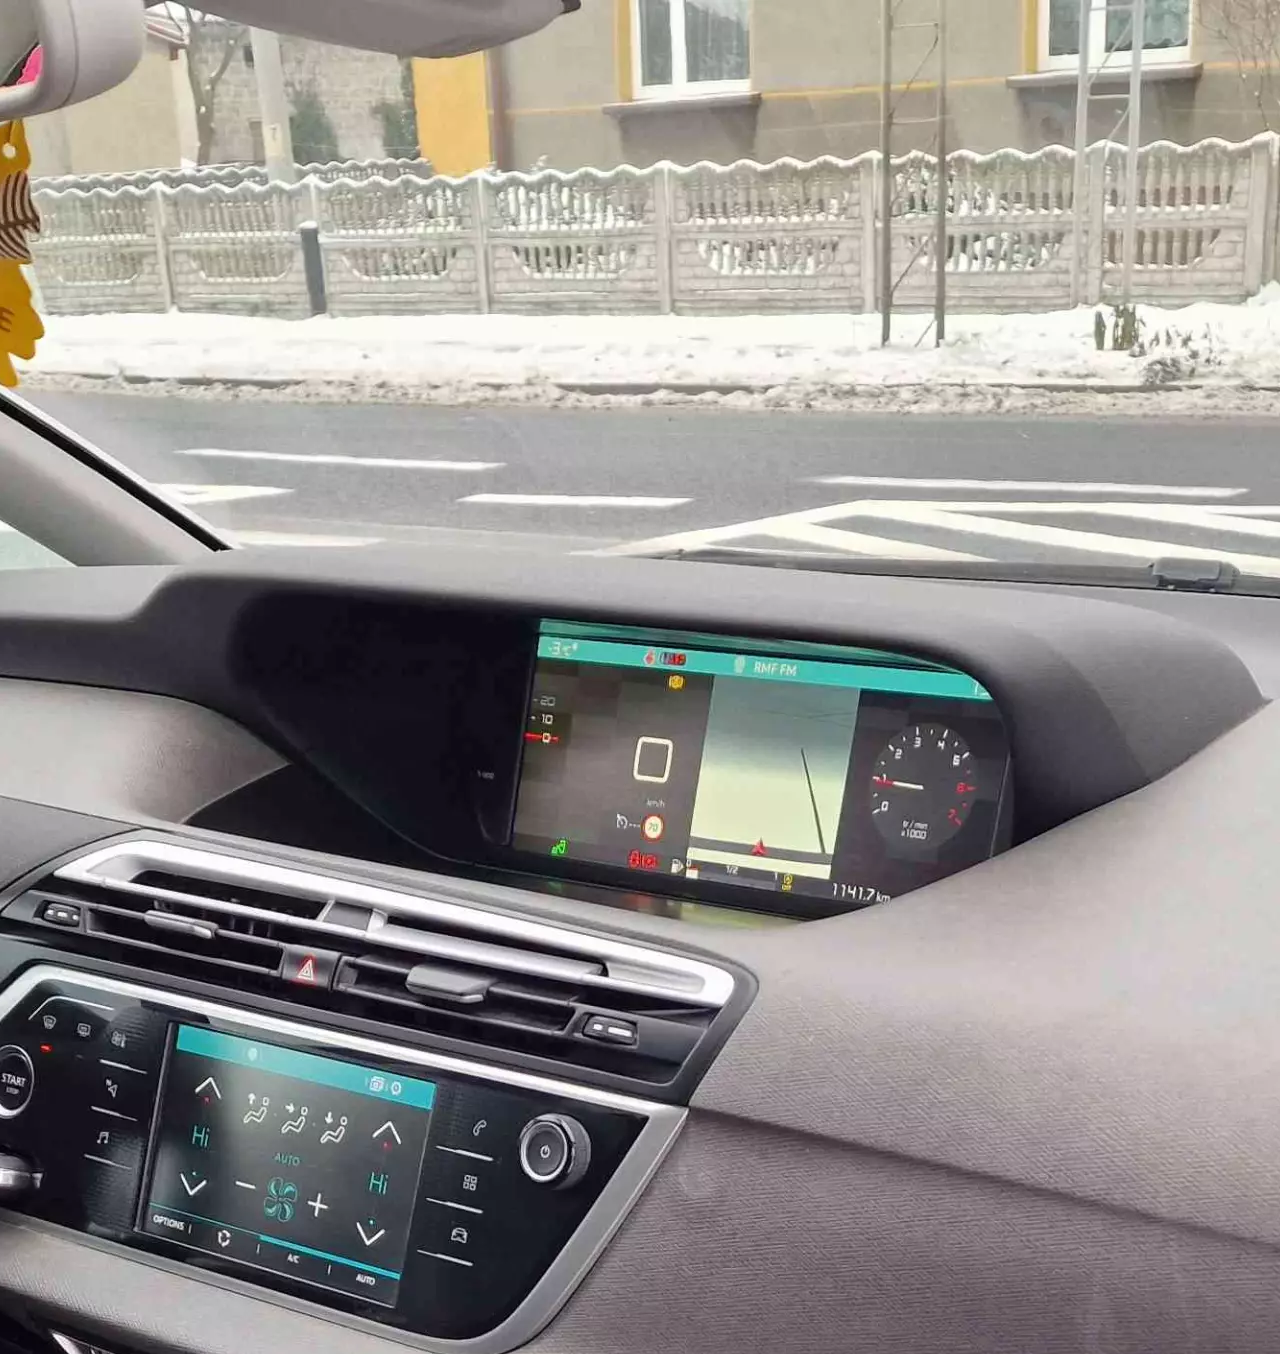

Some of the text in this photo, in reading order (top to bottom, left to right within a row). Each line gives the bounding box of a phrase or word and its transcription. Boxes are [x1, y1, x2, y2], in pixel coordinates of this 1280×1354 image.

[754, 661, 797, 677] RMF FM
[540, 695, 556, 707] 20
[541, 713, 553, 725] 10
[542, 732, 551, 743] 0
[914, 737, 921, 748] 3
[937, 740, 945, 750] 4
[894, 748, 902, 759] 2
[881, 801, 889, 811] 0
[648, 822, 658, 832] 70
[726, 865, 738, 876] 1/2
[833, 883, 891, 903] 1141.7 km
[1, 1073, 26, 1087] START
[192, 1125, 211, 1148] Hi
[274, 1153, 301, 1166] AUTO
[369, 1172, 389, 1195] Hi
[153, 1214, 185, 1231] OPTIONS
[356, 1273, 376, 1285] AUTO
